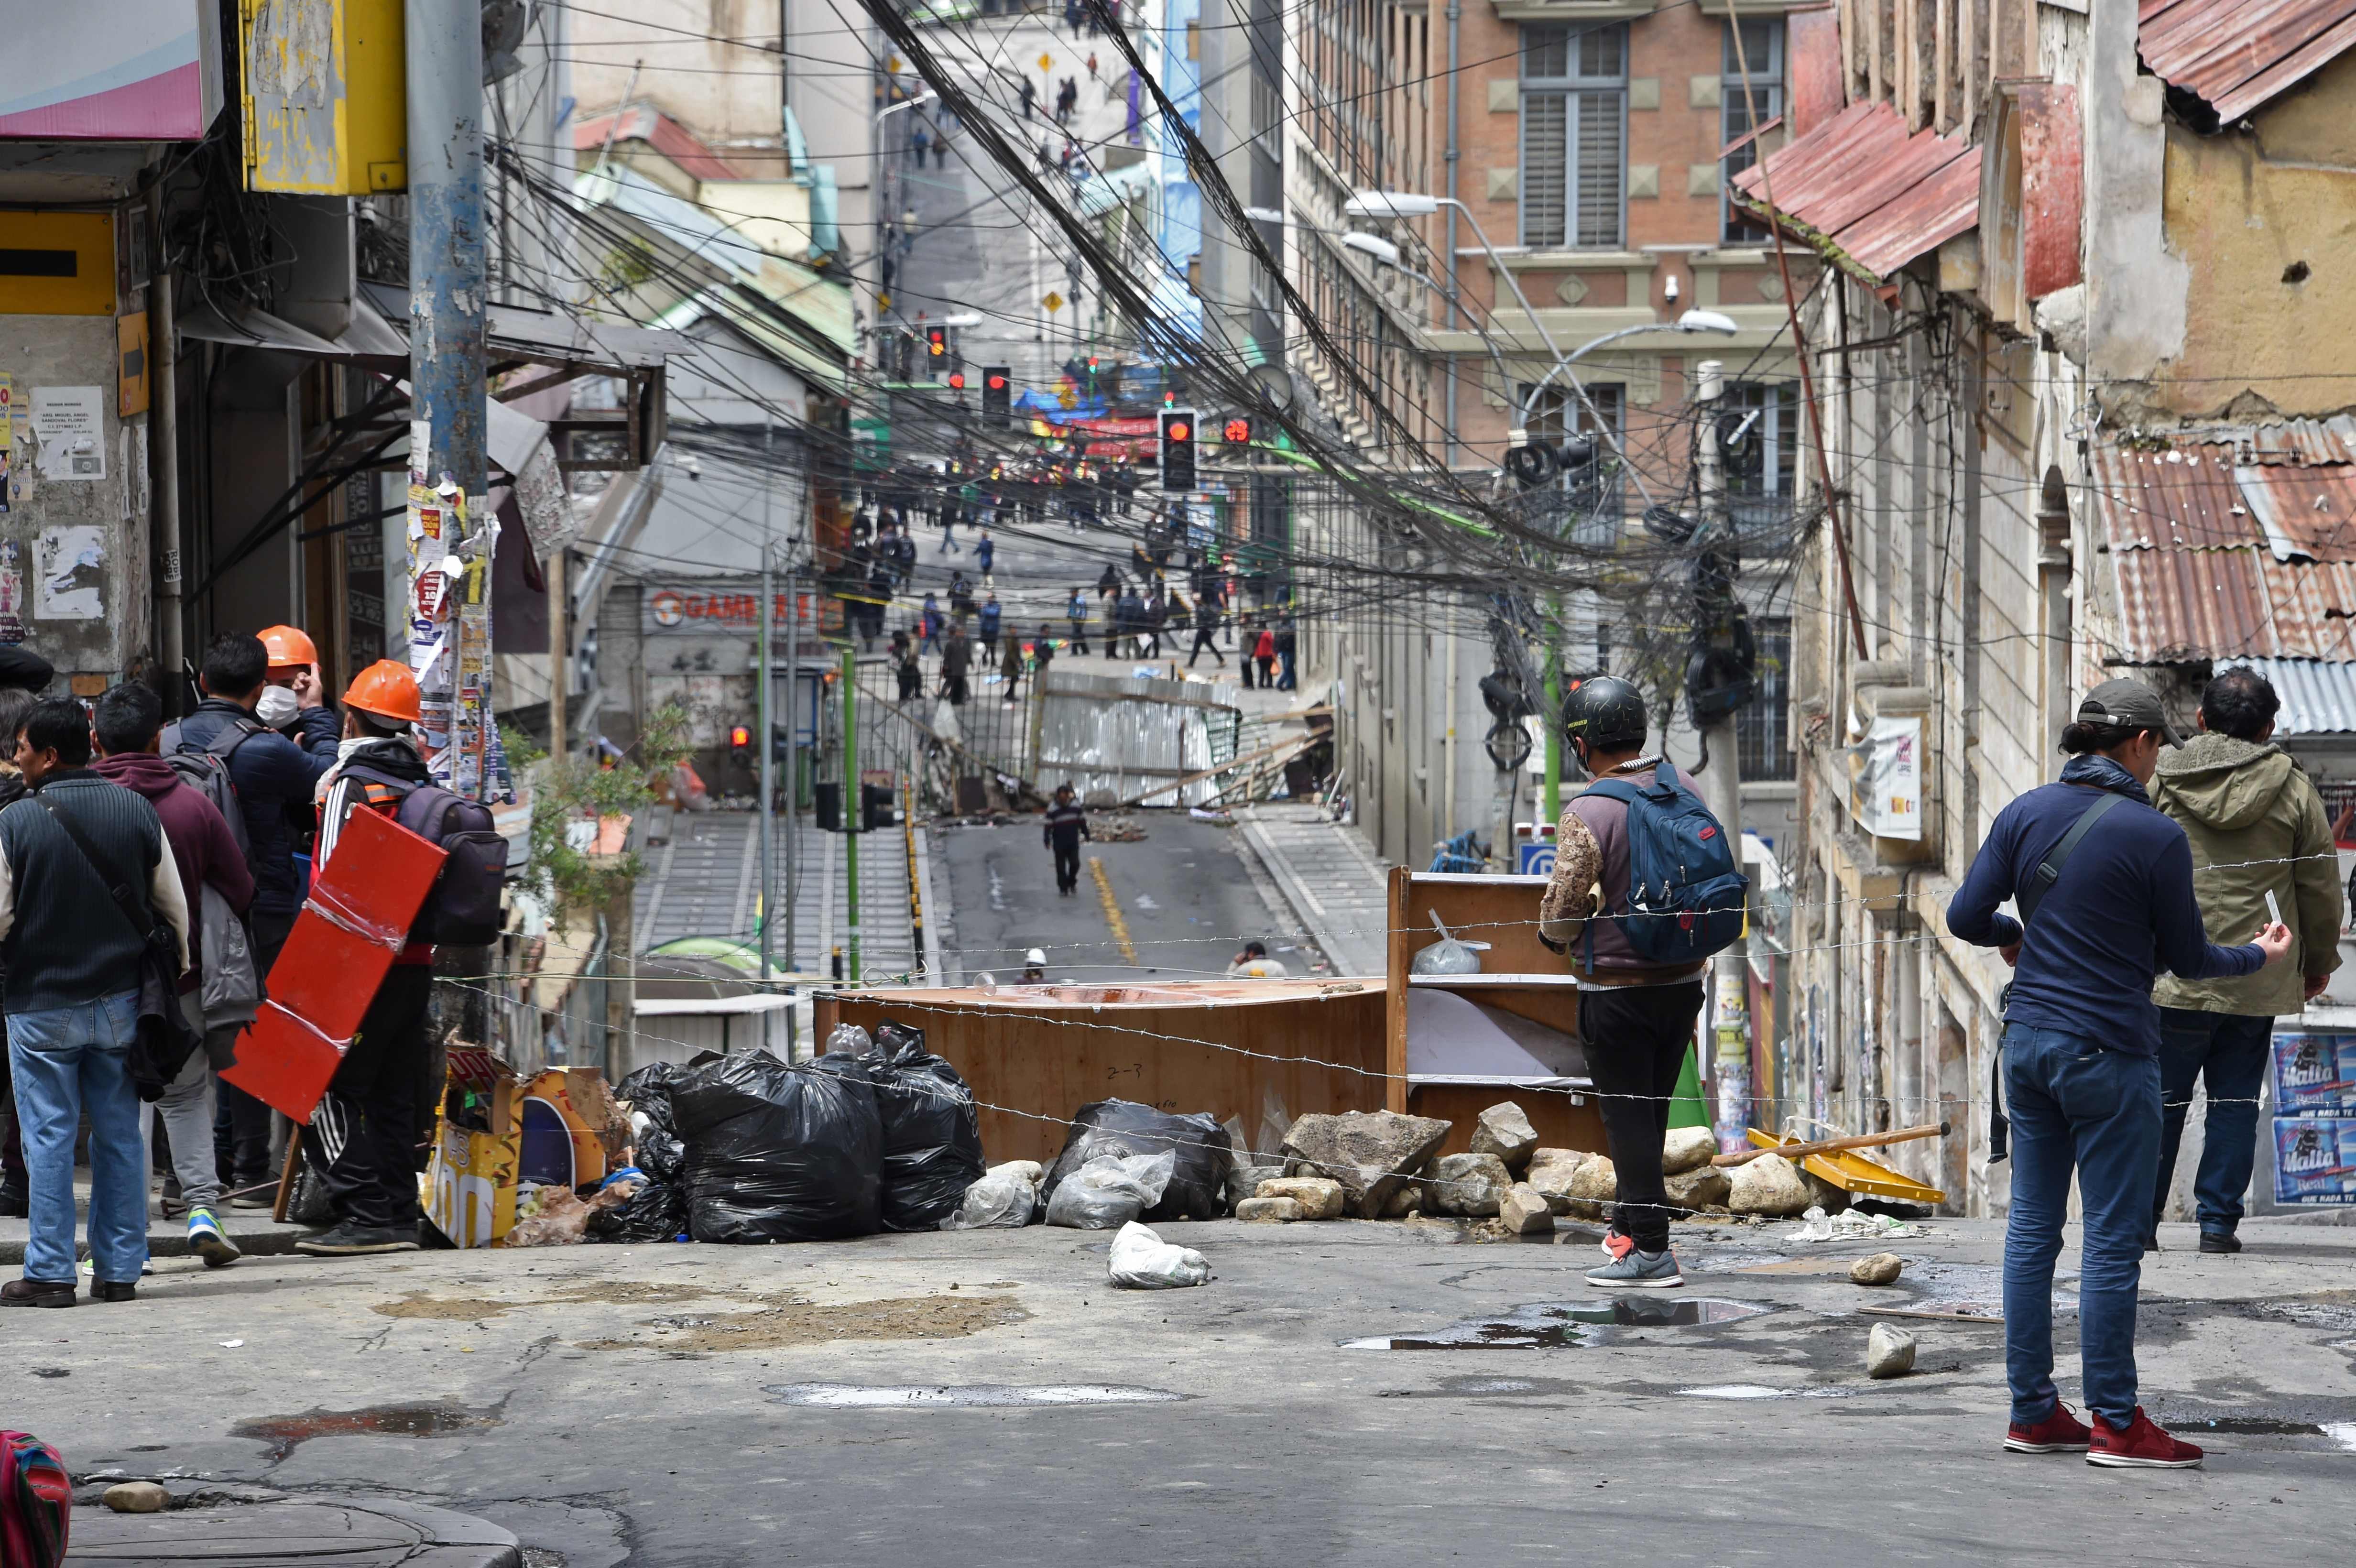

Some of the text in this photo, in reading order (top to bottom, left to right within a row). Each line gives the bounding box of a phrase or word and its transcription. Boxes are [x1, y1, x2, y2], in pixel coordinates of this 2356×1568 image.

[2282, 1063, 2333, 1088] Malta
[2300, 1108, 2354, 1118] QUE NADA TE
[2283, 1149, 2335, 1173] Malta
[2319, 1195, 2341, 1203] NADA
[2345, 1194, 2355, 1202] TE
